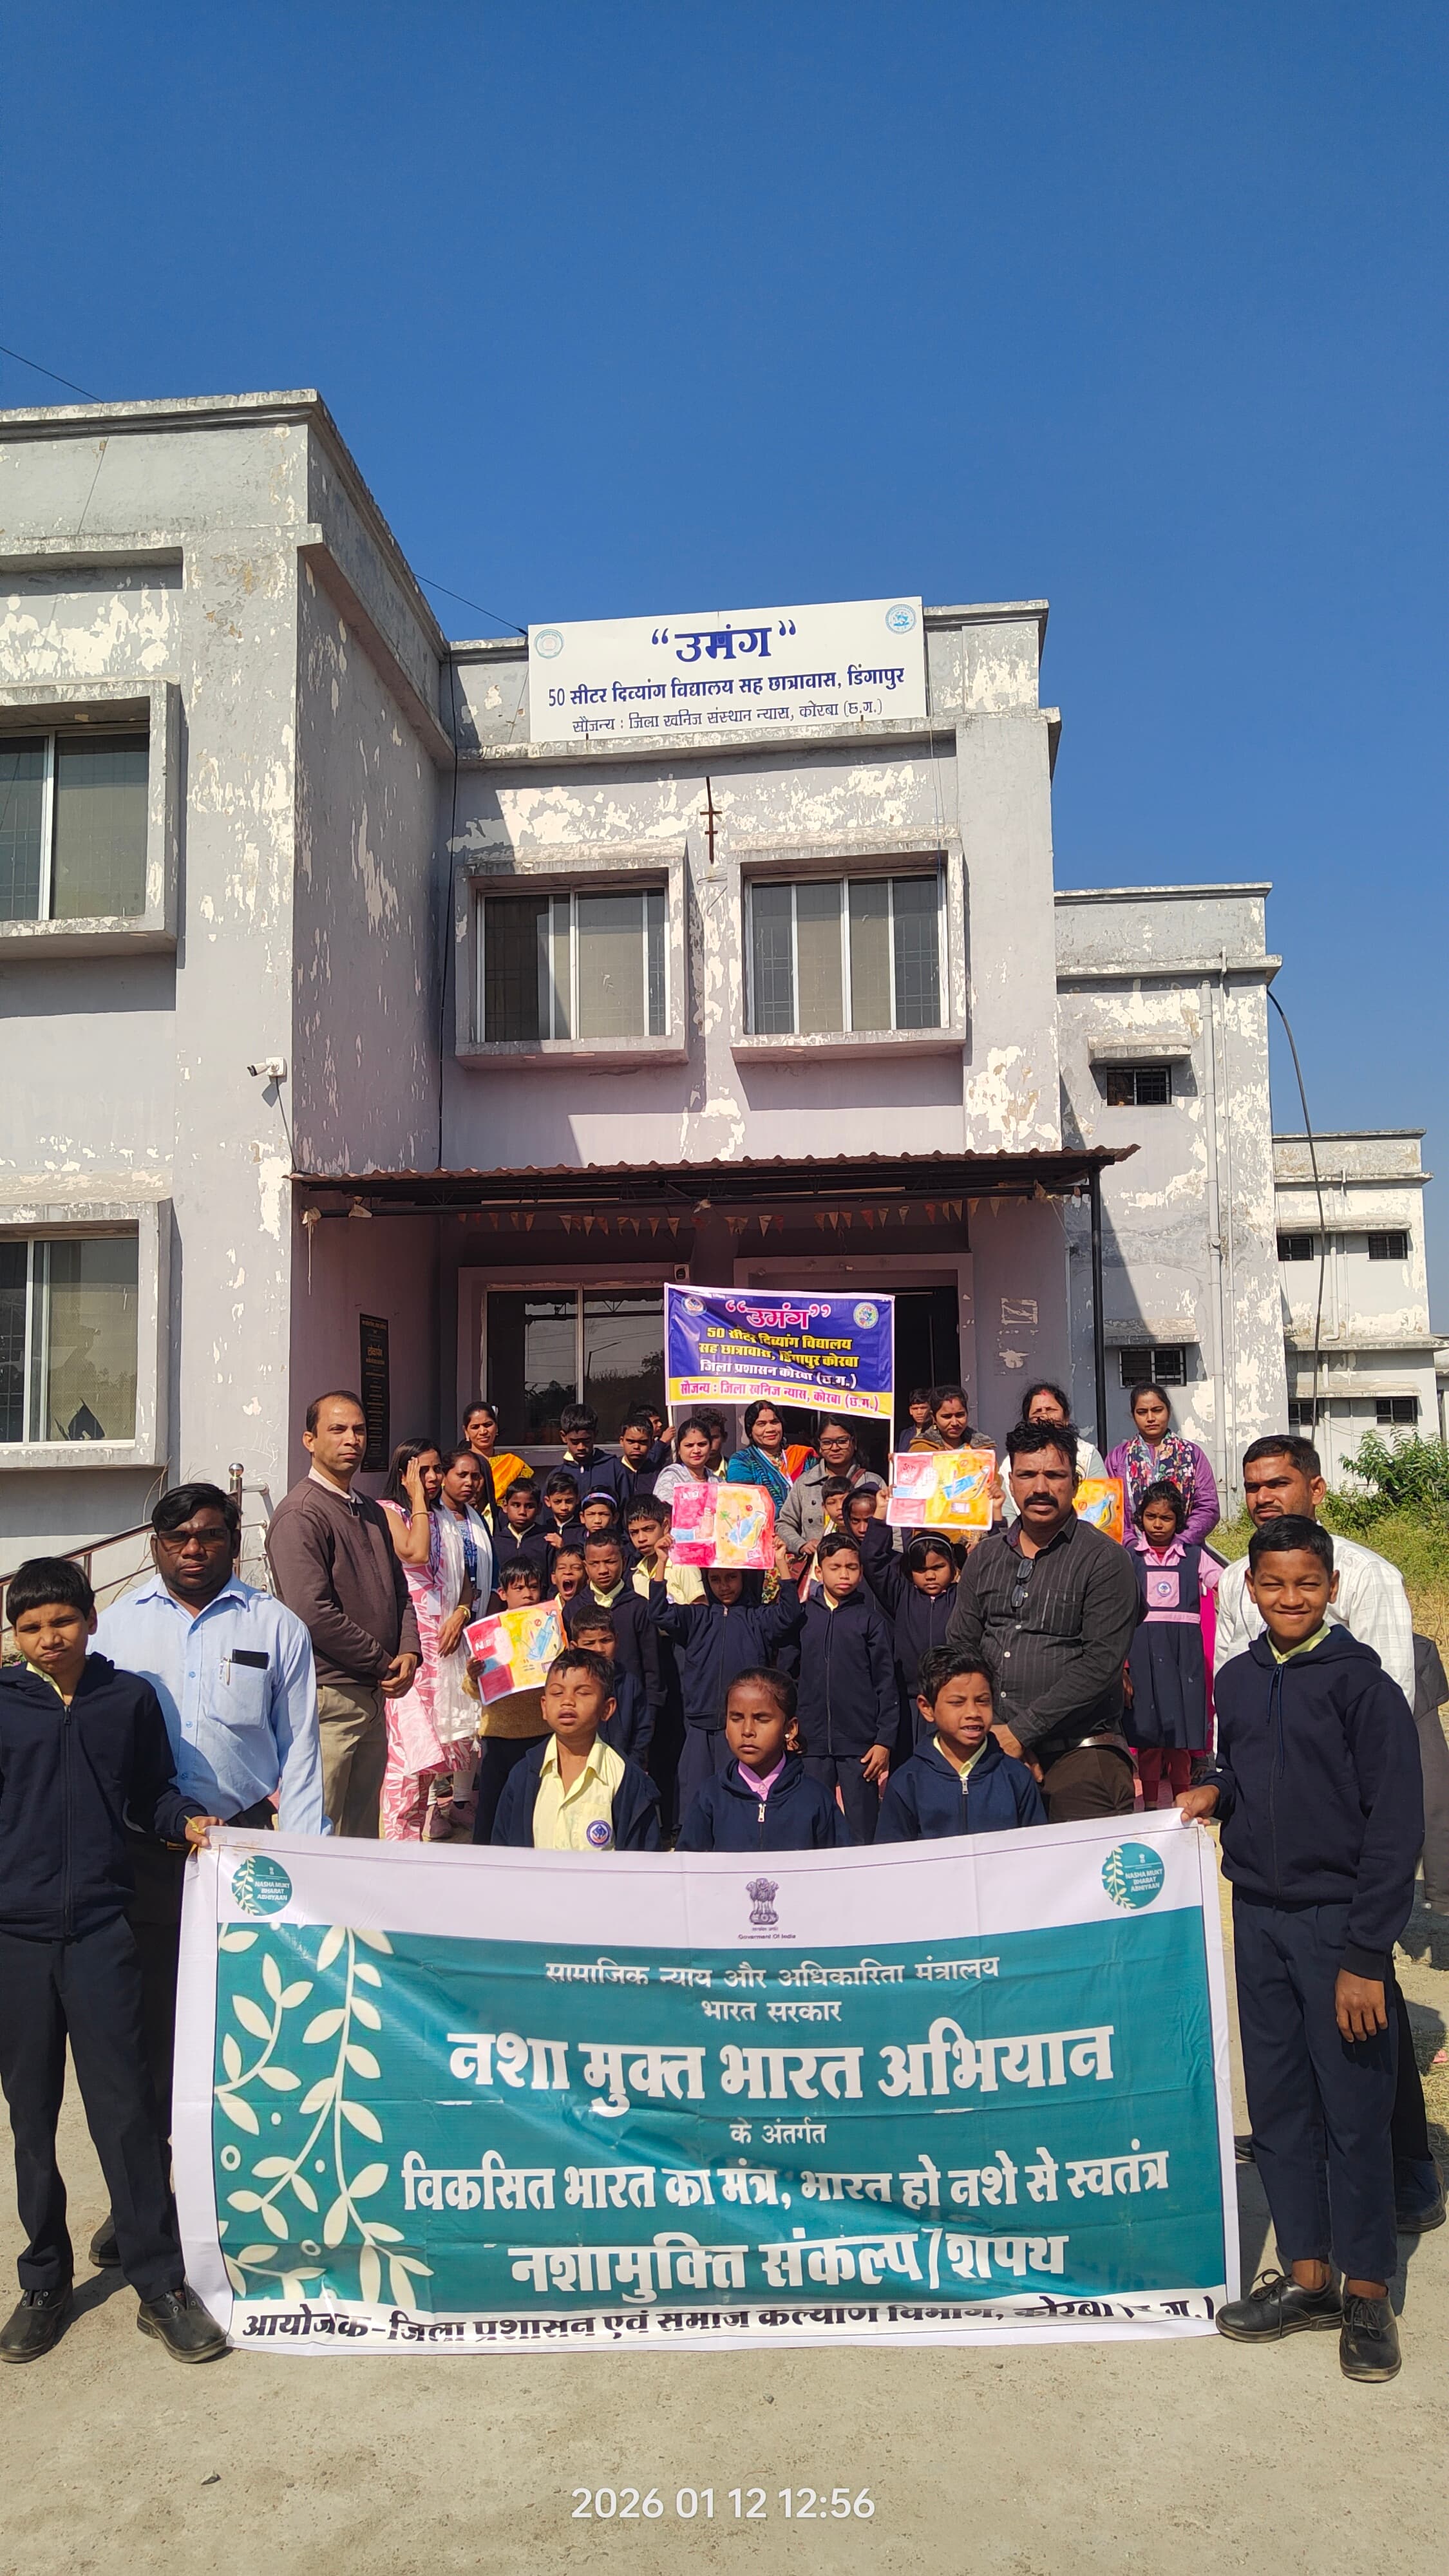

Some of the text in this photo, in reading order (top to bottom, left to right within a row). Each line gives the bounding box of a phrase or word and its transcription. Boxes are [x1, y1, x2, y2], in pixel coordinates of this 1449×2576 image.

[549, 688, 565, 706] 50
[570, 684, 608, 705] सीटर
[671, 677, 734, 698] विद्यालय
[739, 677, 763, 695] सह
[768, 672, 842, 691] छात्रावास,
[847, 664, 905, 690] डिंगापुर
[573, 715, 615, 733] सौजन्य
[629, 712, 659, 729] जिला
[663, 709, 702, 726] खनिज
[707, 706, 752, 724] संस्थान
[757, 707, 794, 721] न्यास,
[799, 700, 839, 717] कोरबा
[844, 698, 882, 717] (छ.ग.)
[707, 1327, 725, 1338] 50
[758, 1332, 800, 1348] दिव्यांग
[802, 1335, 853, 1350] विद्यालय
[699, 1343, 719, 1354] सह
[822, 1352, 860, 1367] कोरबा
[700, 1359, 732, 1372] जिला
[734, 1363, 778, 1376] प्रशासन
[779, 1365, 813, 1381] कोरबा
[681, 1379, 711, 1395] सौजन्य
[720, 1380, 746, 1394] जिला
[749, 1383, 781, 1397] खनिज
[784, 1387, 810, 1403] न्यास,
[813, 1390, 841, 1405] कोरबा
[845, 1394, 878, 1412] (छ.ग.)
[1124, 1871, 1146, 1879] NASHA
[1130, 1882, 1160, 1892] ABHIYAAN
[1133, 1877, 1157, 1885] BHARAT
[546, 1955, 999, 1989] सामाजिक न्याय और अधिकारिता मंत्रालय
[701, 2000, 842, 2022] भारत सरकार
[447, 2017, 1115, 2117] नशा मुक्त भारत अभियान
[730, 2116, 827, 2145] के अंतर्गत
[401, 2138, 1170, 2211] विकसित भारत का मंत्र, भारत हो नशे से स्वतंत्र
[507, 2226, 1070, 2304] नशामुक्ति संकल्प/शपथ
[601, 2309, 650, 2340] एवं
[656, 2311, 751, 2332] समाज
